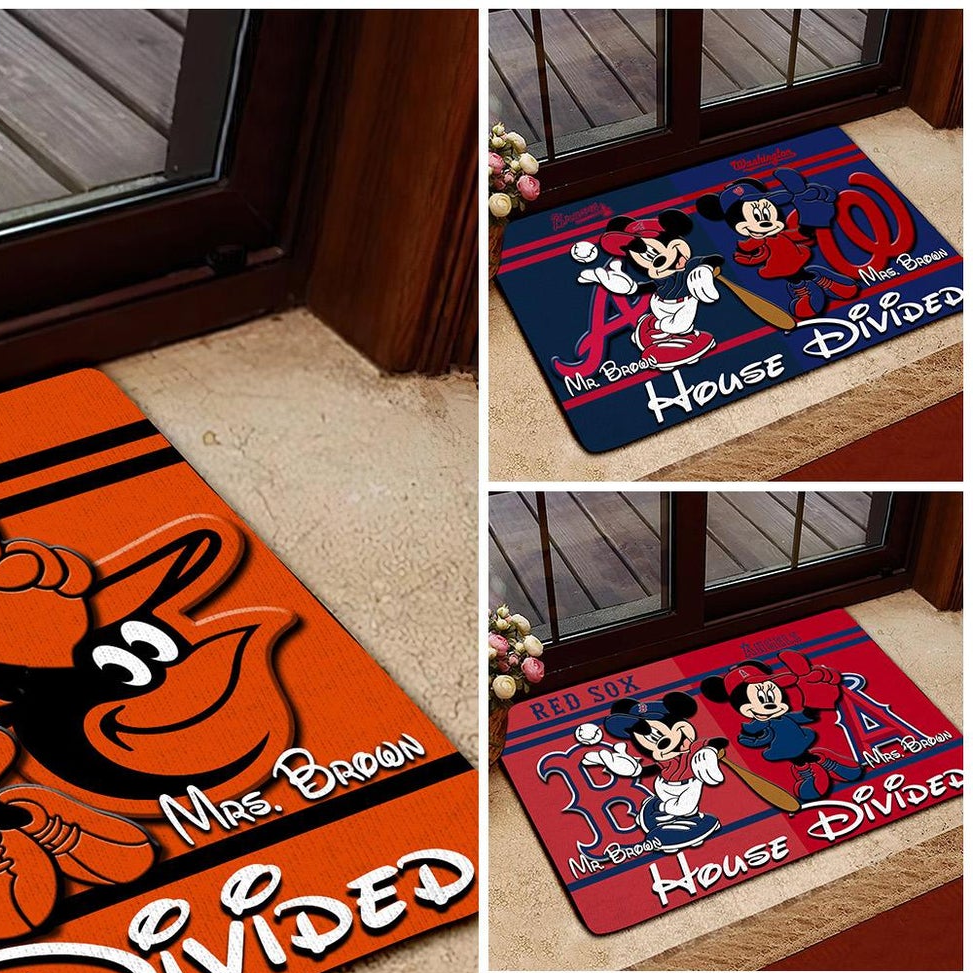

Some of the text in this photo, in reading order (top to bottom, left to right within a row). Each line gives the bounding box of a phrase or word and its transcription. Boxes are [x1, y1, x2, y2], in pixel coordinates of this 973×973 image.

[645, 354, 786, 424] HOUSE
[530, 674, 641, 721] RED SOX
[537, 741, 656, 862] B
[649, 835, 791, 907] HOUSE
